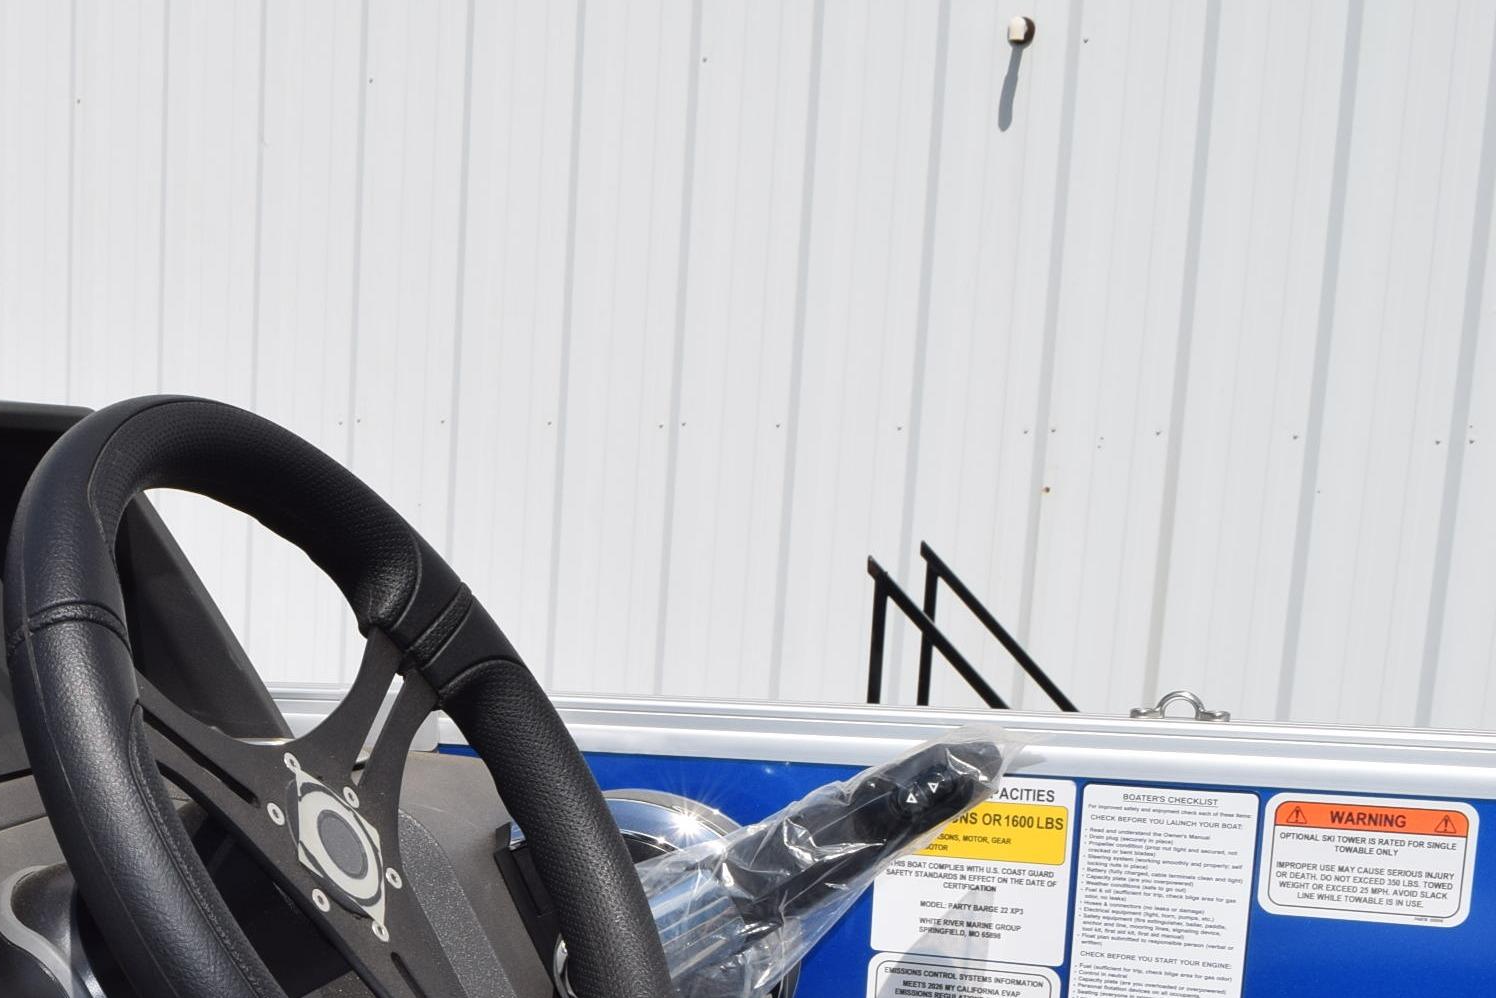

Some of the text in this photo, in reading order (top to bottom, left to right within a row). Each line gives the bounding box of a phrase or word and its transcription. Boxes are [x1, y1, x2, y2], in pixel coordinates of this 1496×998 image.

[1123, 794, 1218, 806] BOATER'S CHECKLIST
[983, 814, 1002, 826] OR
[1005, 815, 1034, 828] 1600
[1036, 817, 1064, 830] LBS
[1091, 814, 1117, 823] CHECK
[1117, 816, 1148, 824] BEFORE
[1166, 819, 1198, 828] LAUNCH
[1198, 821, 1220, 829] YOUR
[1331, 812, 1406, 828] WARNING
[991, 837, 1012, 845] GEAR
[1280, 833, 1320, 842] OPTIONAL
[1322, 835, 1336, 843] SKI
[1338, 836, 1367, 845] TOWER
[1378, 839, 1406, 847] RATED
[1407, 841, 1425, 849] FOR
[1426, 842, 1456, 850] SINGLE
[1336, 846, 1398, 857] TOWABLE ONLY
[907, 862, 927, 870] BOAT
[928, 863, 965, 872] COMPLIES
[966, 866, 985, 874] WITH
[1001, 868, 1026, 876] COAST
[1027, 870, 1054, 878] GUARD
[1277, 862, 1318, 871] IMPROPER
[1337, 866, 1355, 874] MAY
[1356, 867, 1385, 876] CAUSE
[1387, 869, 1423, 878] SERIOUS
[1424, 871, 1455, 880] INJURY
[887, 869, 913, 878] SAFETY
[914, 871, 958, 881] STANDARDS
[959, 874, 967, 882] IN
[968, 875, 995, 884] EFFECT
[1010, 878, 1024, 886] THE
[1025, 879, 1045, 887] DATE
[1046, 880, 1057, 888] OF
[1333, 875, 1350, 883] NOT
[1352, 877, 1386, 886] EXCEED
[1387, 879, 1401, 887] 350
[1423, 882, 1453, 890] TOWED
[944, 882, 997, 893] CERTIFICATION
[1279, 881, 1309, 890] WEIGHT
[1325, 884, 1358, 893] EXCEED
[1392, 889, 1418, 897] AVOID
[1420, 891, 1447, 899] SLACK
[1298, 893, 1315, 901] LINE
[1316, 894, 1342, 903] WHILE
[1344, 896, 1384, 906] TOWABLE
[1385, 899, 1393, 907] IS
[948, 903, 972, 911] PARTY
[972, 905, 999, 913] BARGE
[920, 918, 1021, 932] WHITE RIVER MARINE GROUP
[885, 968, 1044, 988] EMISSIONS CONTROL SYSTEMS INFORMATION
[895, 989, 933, 998] EMISSIONS
[904, 981, 927, 989] MEETS
[944, 984, 955, 992] MY
[956, 986, 1000, 996] CALIFORNIA
[1001, 990, 1021, 998] EVAP
